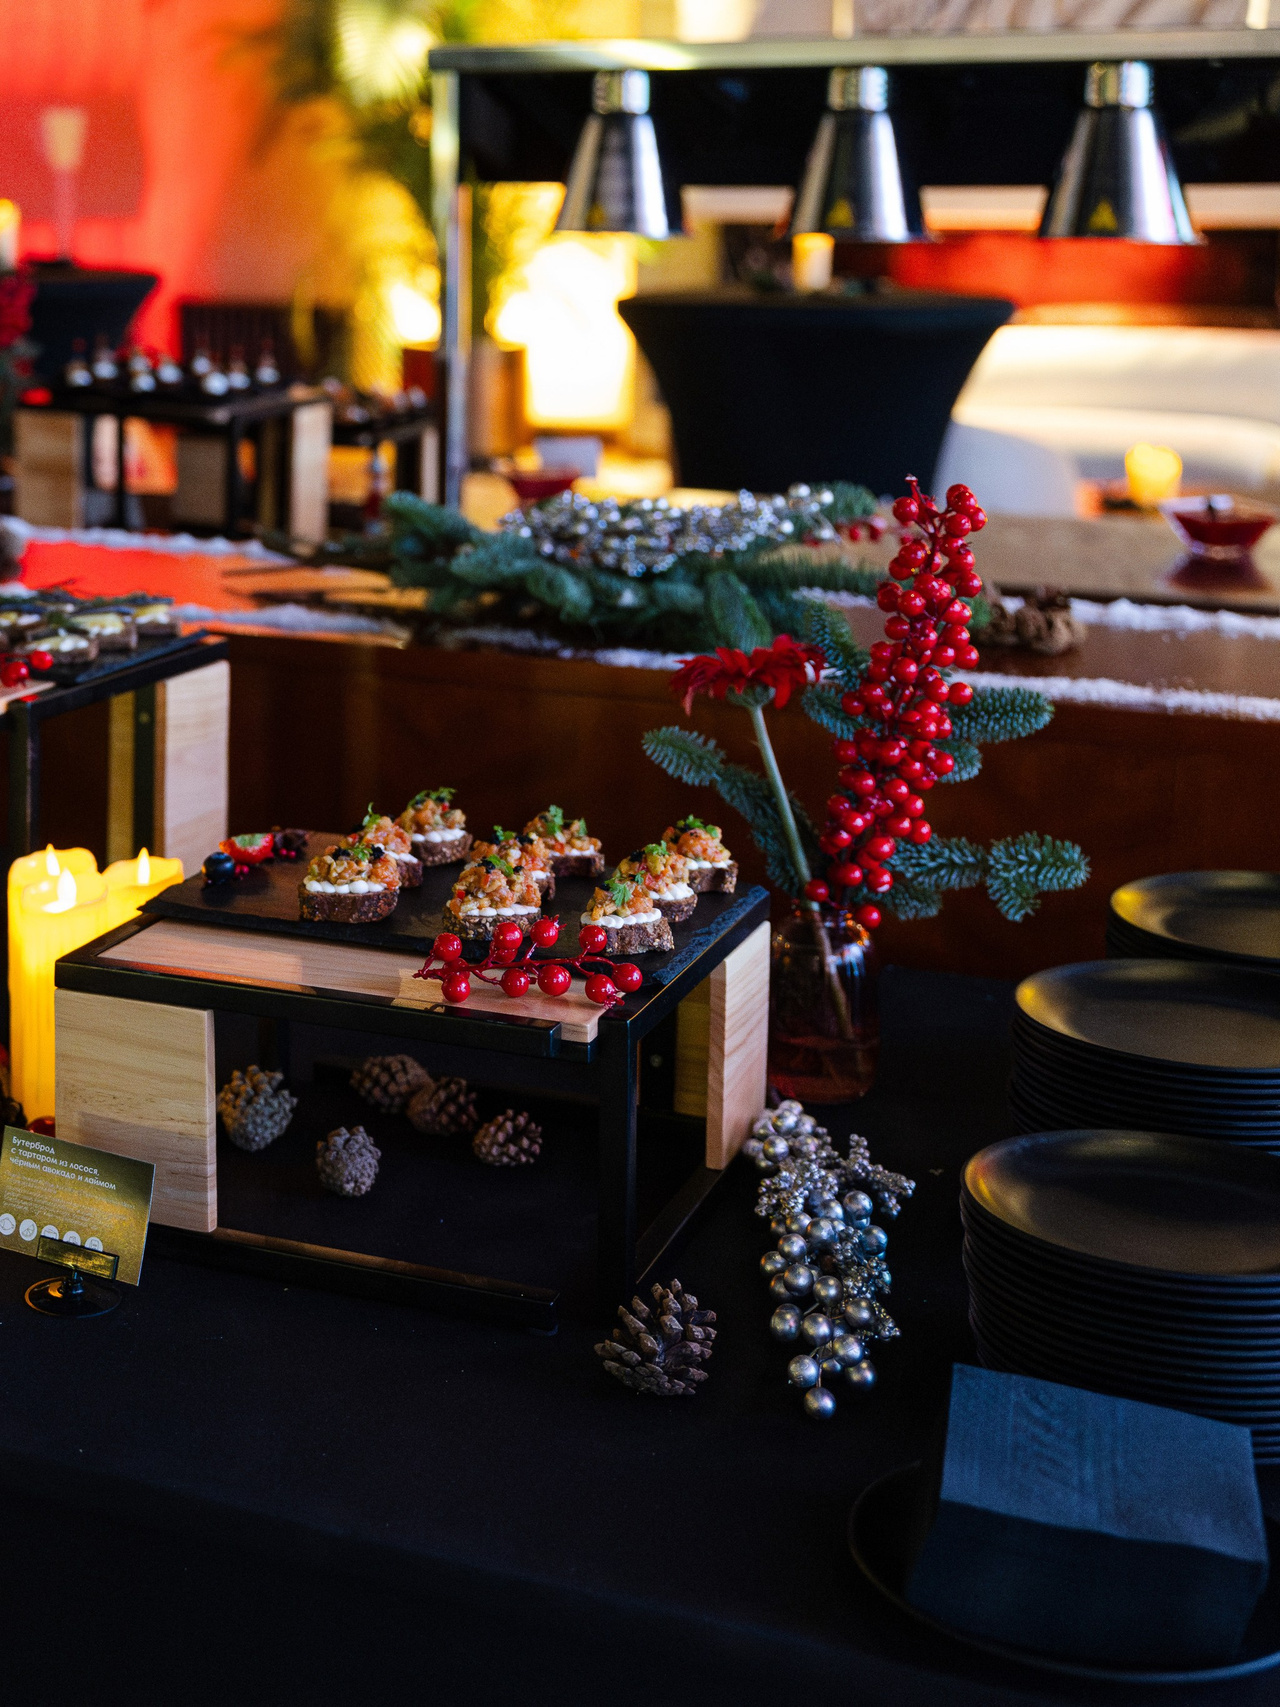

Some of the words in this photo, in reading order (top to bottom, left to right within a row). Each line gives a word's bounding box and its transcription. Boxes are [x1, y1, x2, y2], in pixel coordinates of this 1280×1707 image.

[12, 1136, 55, 1155] Бутерброд
[9, 1156, 41, 1171] чёрным
[42, 1165, 76, 1180] авокадо
[84, 1177, 116, 1190] лаймом
[18, 1148, 58, 1165] тартаром
[59, 1159, 68, 1168] из
[69, 1162, 100, 1176] лосося,
